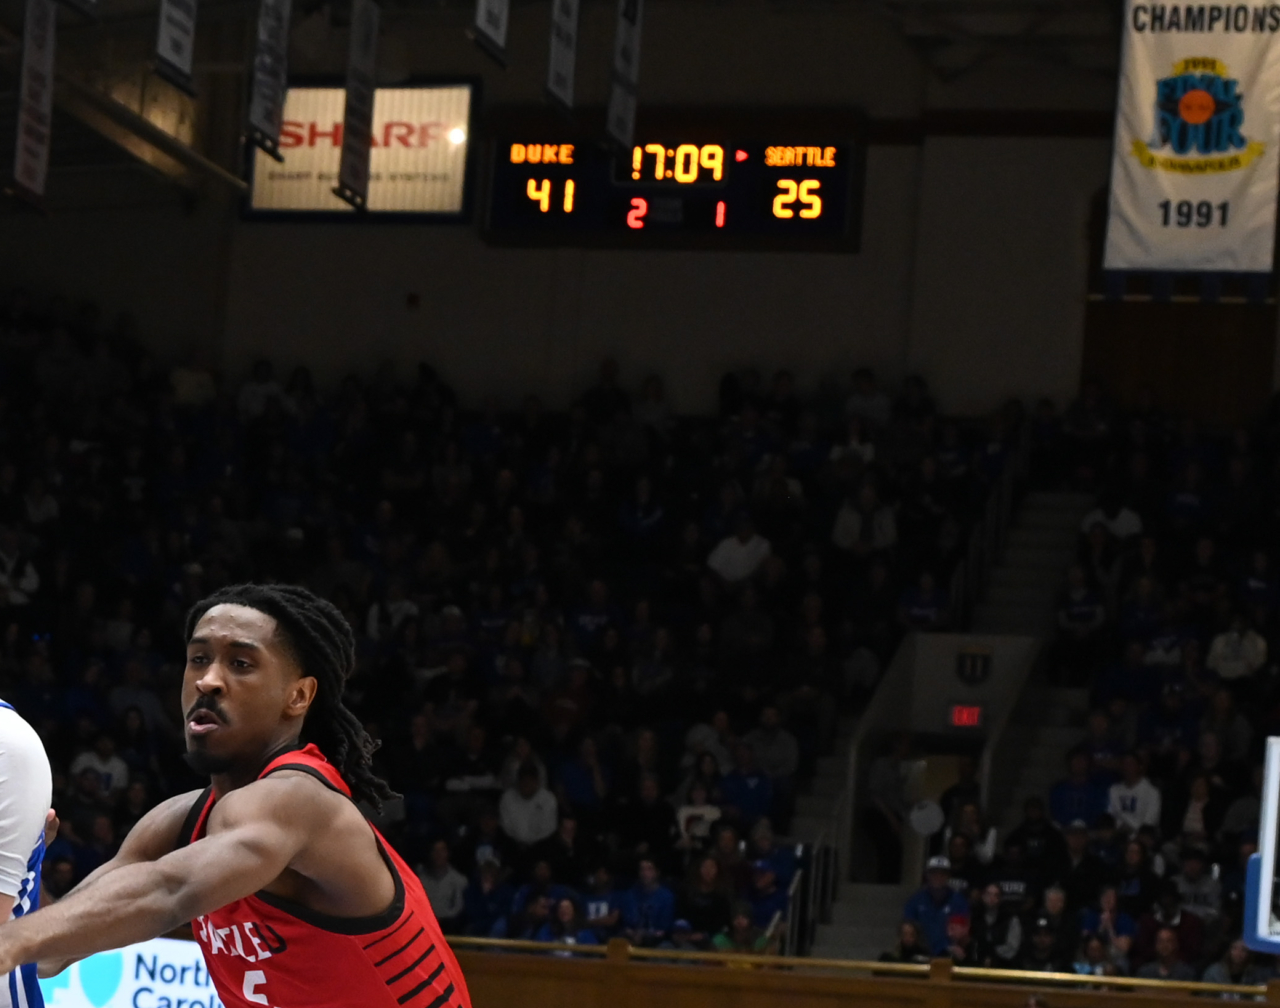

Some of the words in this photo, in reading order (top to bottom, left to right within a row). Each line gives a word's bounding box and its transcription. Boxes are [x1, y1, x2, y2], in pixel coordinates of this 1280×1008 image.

[510, 143, 575, 165] DUKE
[631, 143, 724, 183] 17:09
[764, 145, 837, 168] SEATTLE
[526, 178, 575, 213] 41
[772, 178, 822, 219] 25
[627, 197, 648, 229] 2
[1159, 200, 1230, 228] 1991
